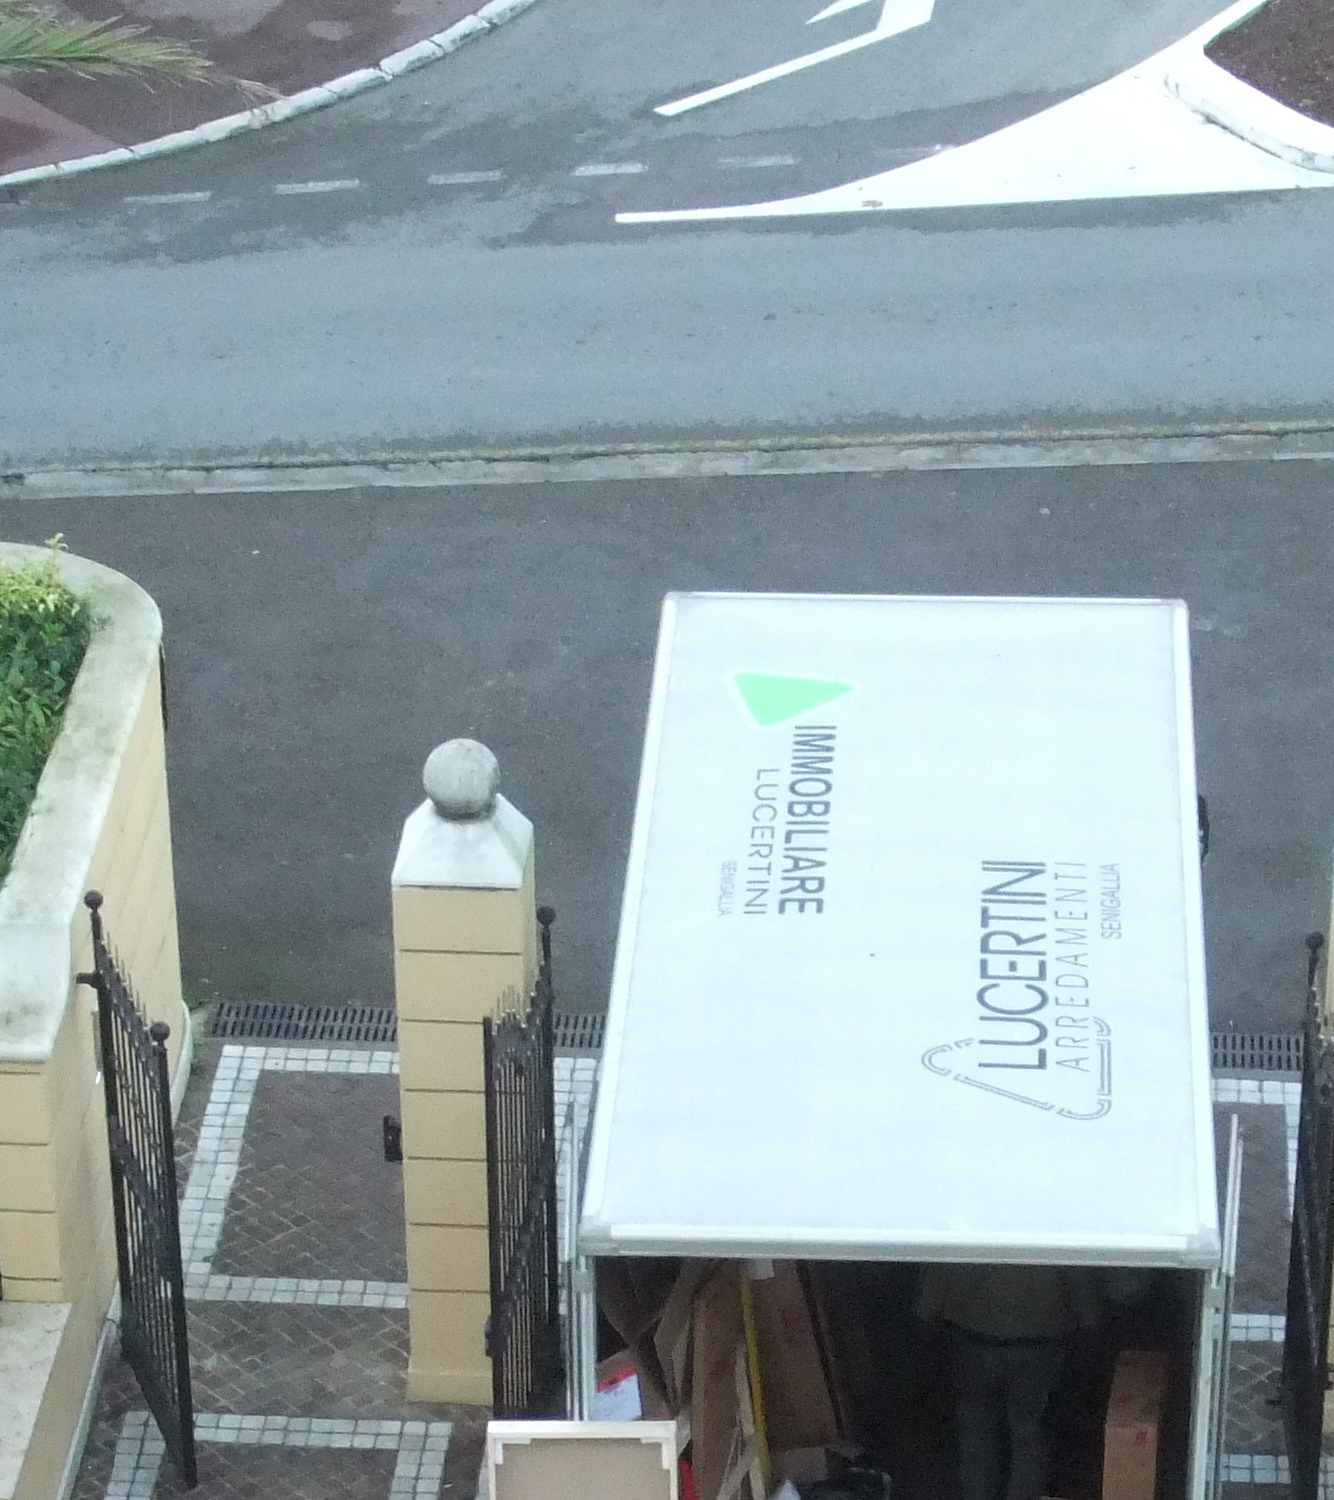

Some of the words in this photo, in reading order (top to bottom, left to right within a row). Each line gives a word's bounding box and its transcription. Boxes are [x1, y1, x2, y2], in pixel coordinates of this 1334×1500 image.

[743, 768, 780, 914] LUCERTINI
[778, 725, 837, 914] IMMOBILIARE
[1100, 862, 1122, 939] SENIGALLIA
[976, 860, 1049, 1070] LUCERTINI
[1054, 861, 1090, 1072] ARREDAMENTI
